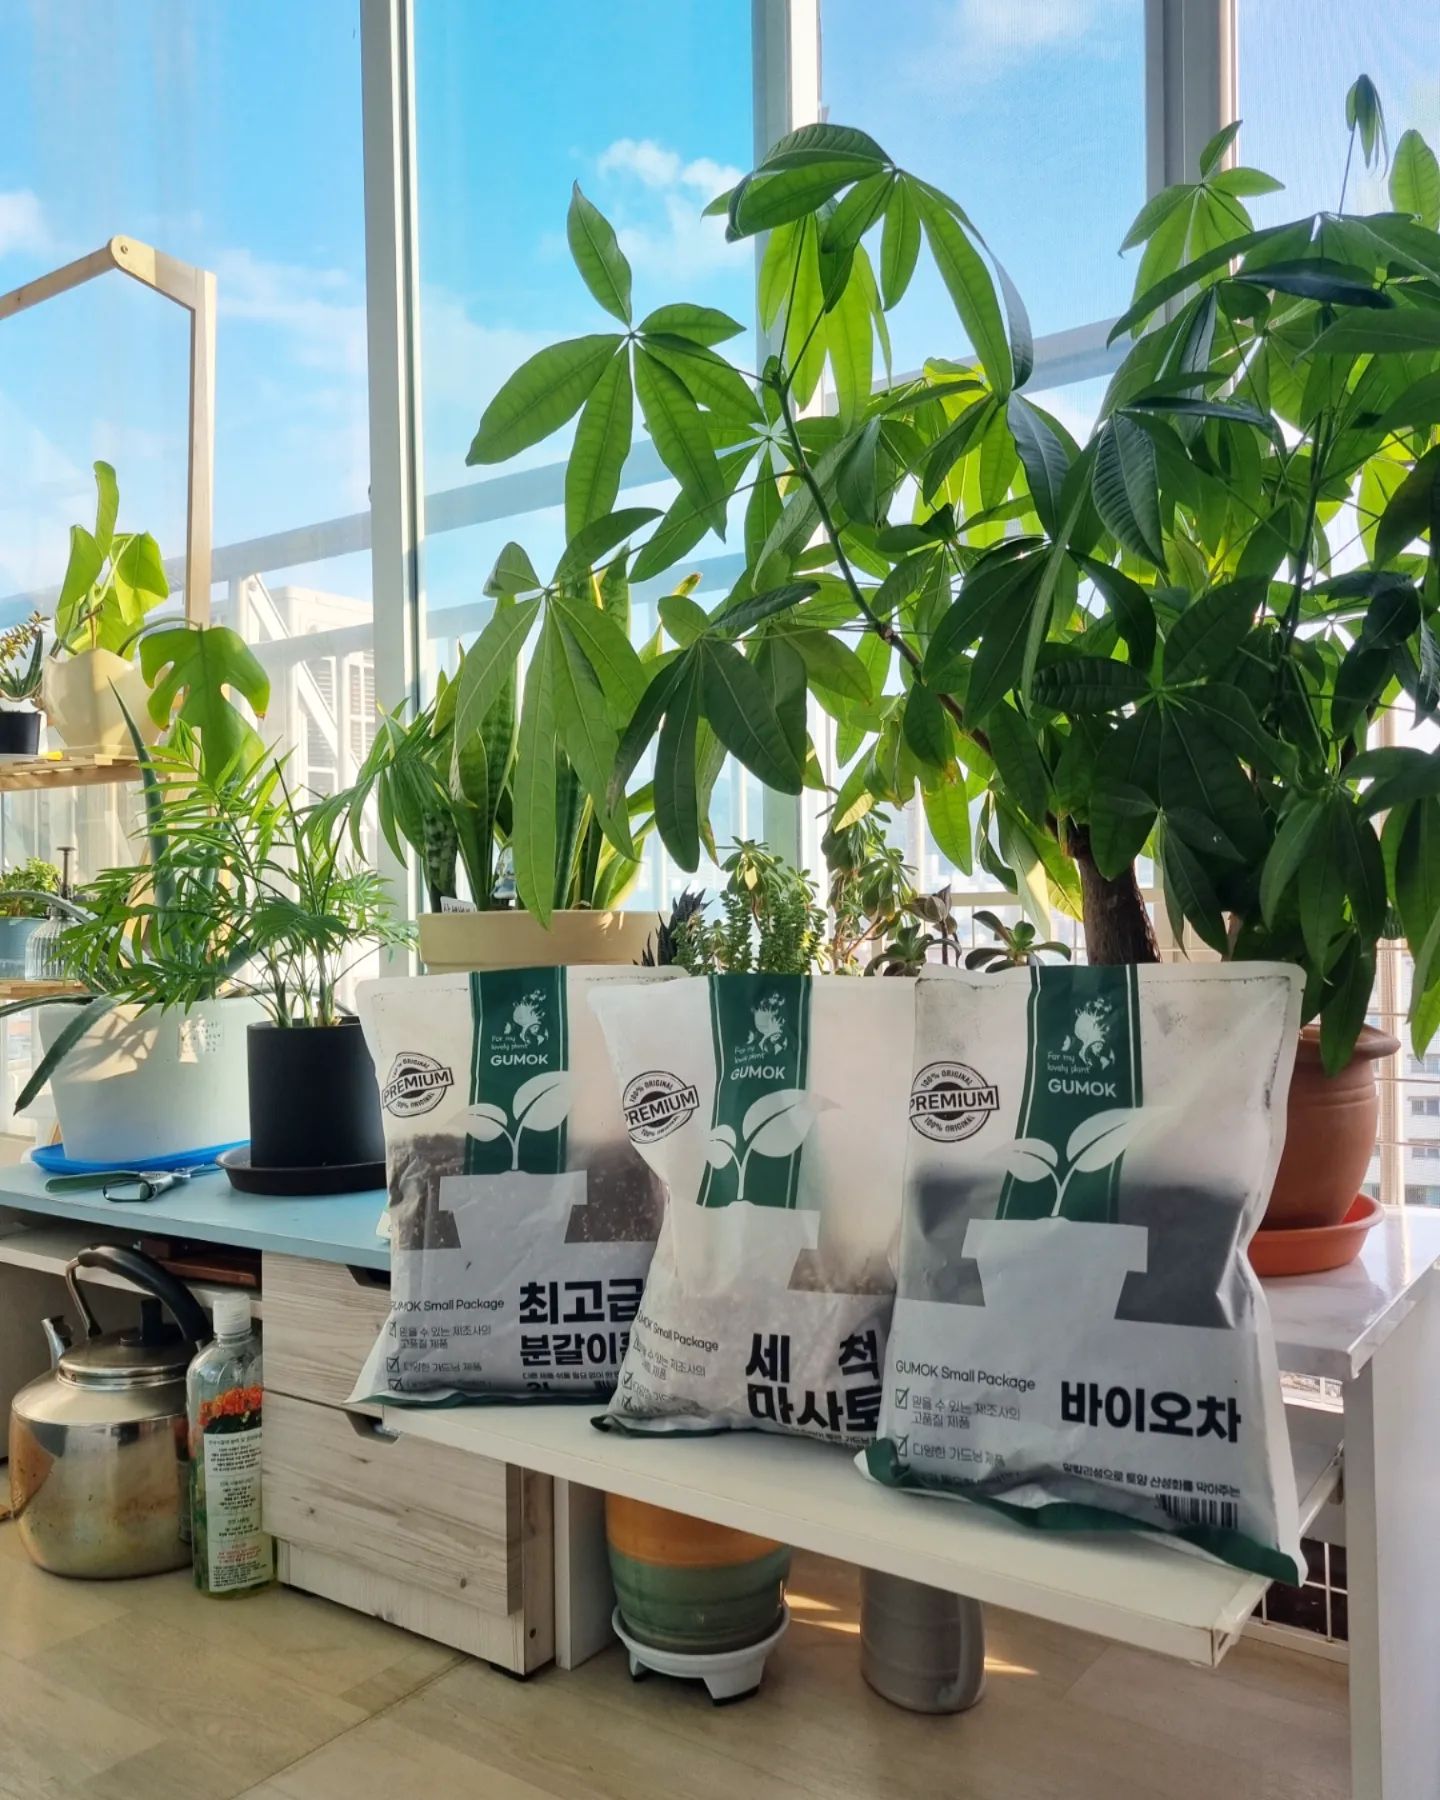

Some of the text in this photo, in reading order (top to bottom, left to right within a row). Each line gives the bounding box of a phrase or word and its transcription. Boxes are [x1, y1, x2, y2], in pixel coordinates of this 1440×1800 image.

[490, 1054, 549, 1066] GUMOK
[730, 1065, 785, 1080] GUMOK
[921, 1070, 973, 1088] 100% ORIGINAL
[383, 1071, 449, 1102] PREMIUM
[1048, 1078, 1117, 1098] GUMOK
[945, 1115, 976, 1132] ORIGINAL
[423, 1300, 454, 1312] Small
[456, 1299, 504, 1311] Package
[519, 1278, 644, 1325] 최고급
[653, 1322, 672, 1340] Small
[673, 1331, 719, 1352] Package
[896, 1360, 1036, 1392] GUMOK Small Package
[747, 1383, 882, 1432] 마사토
[935, 1399, 945, 1411] 수
[949, 1400, 972, 1415] 있는
[975, 1402, 1020, 1421] 제조사의
[1061, 1381, 1241, 1443] 바이오차
[948, 1415, 970, 1429] 제품
[913, 1443, 946, 1459] 다양한
